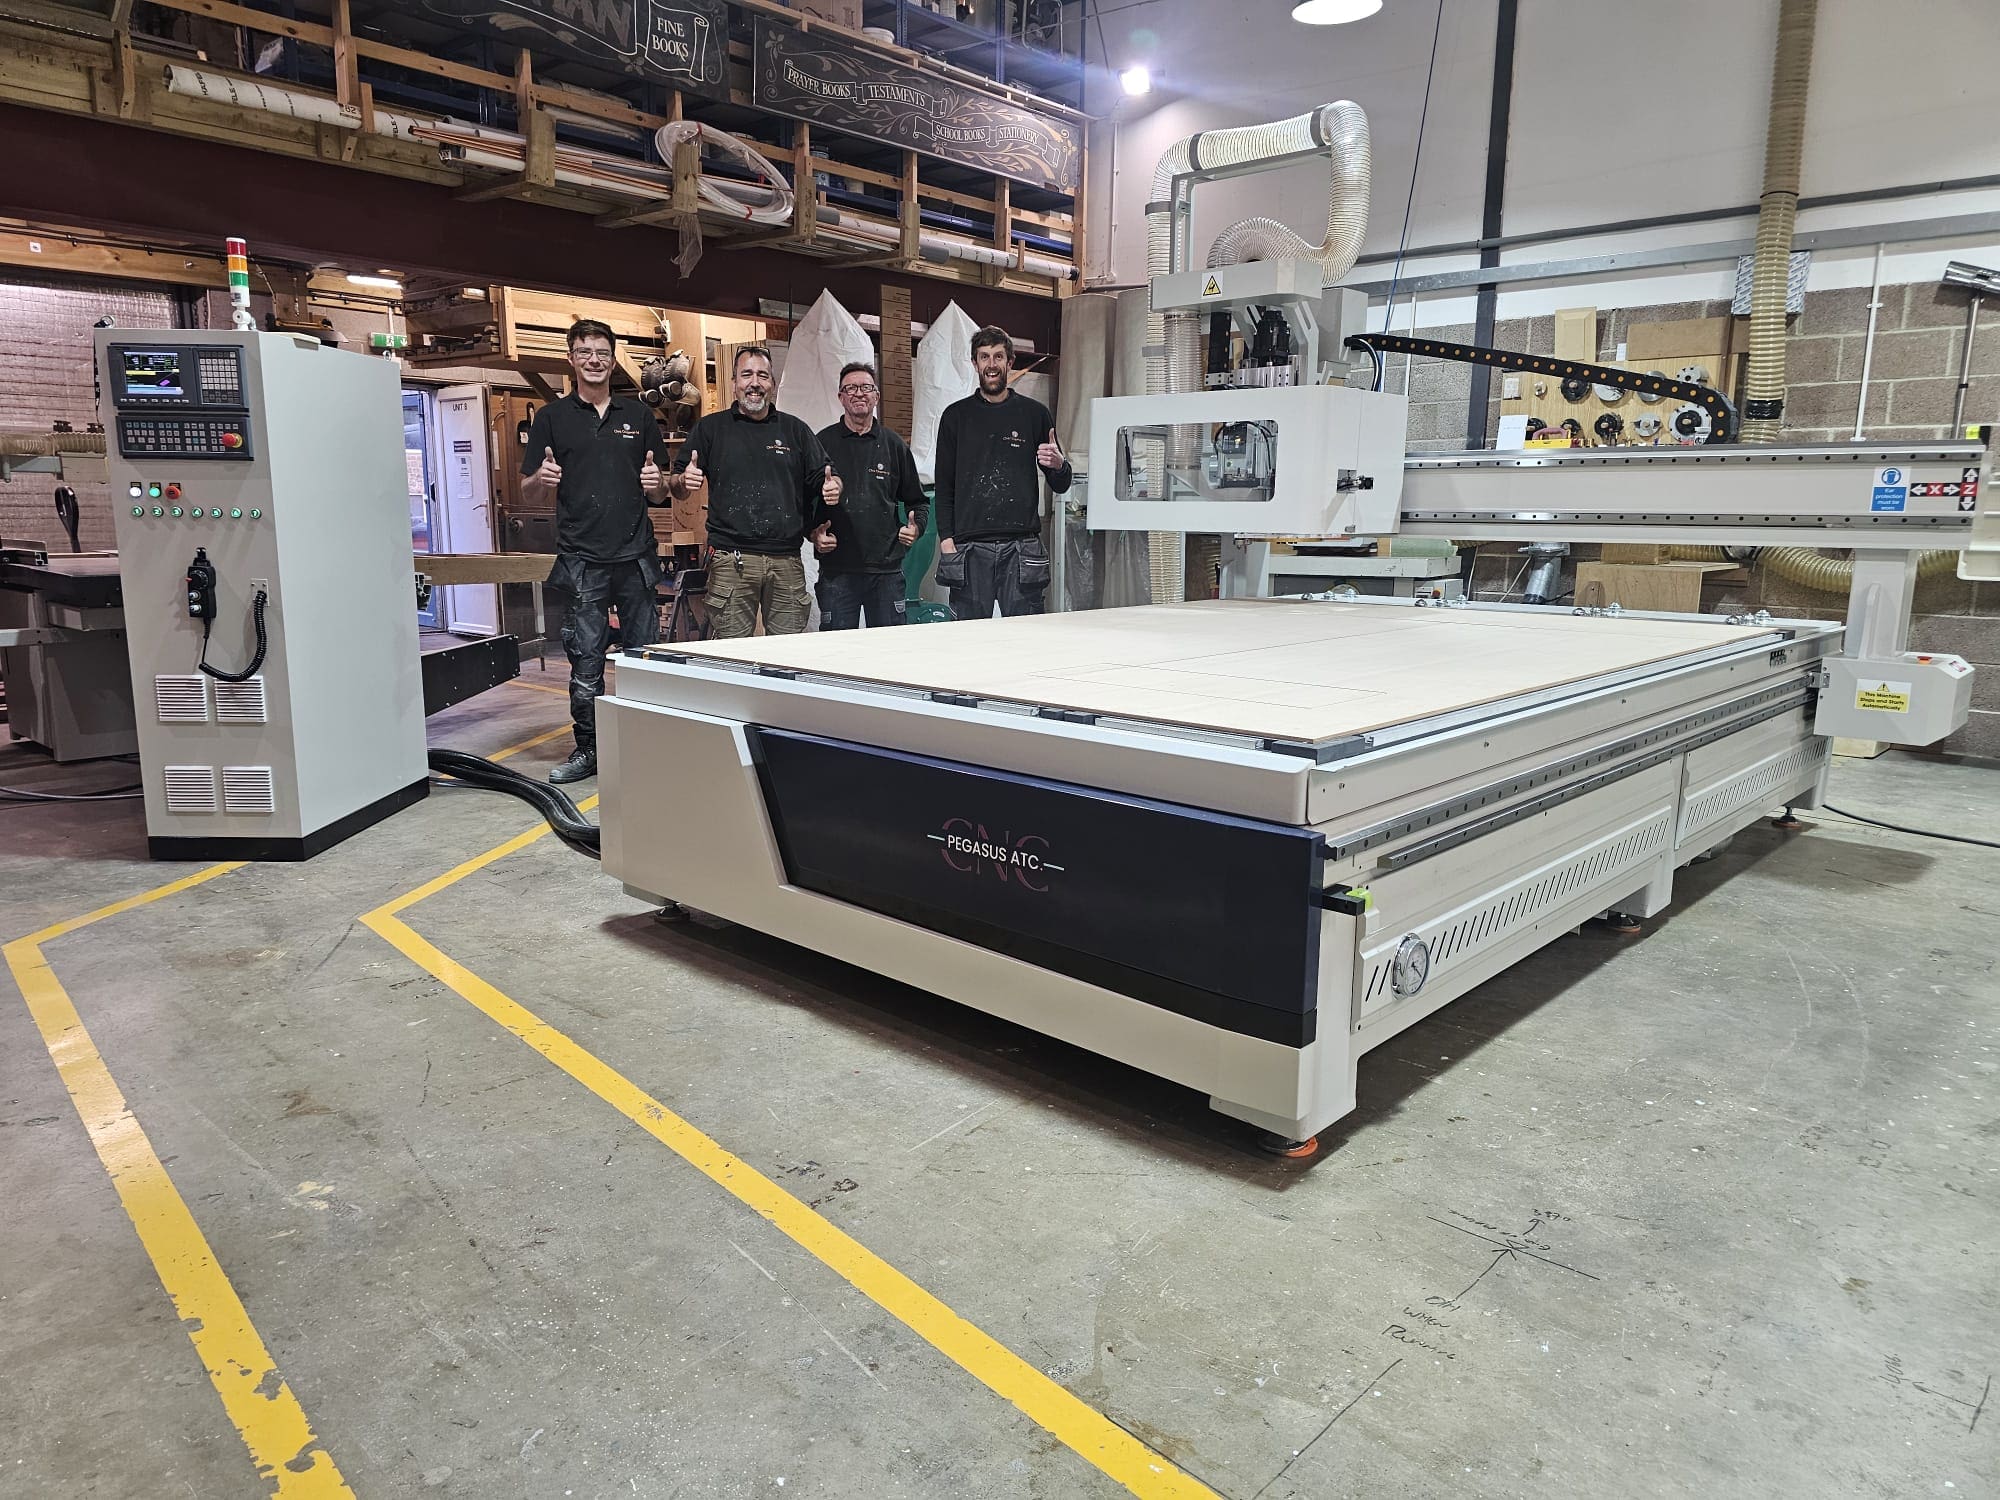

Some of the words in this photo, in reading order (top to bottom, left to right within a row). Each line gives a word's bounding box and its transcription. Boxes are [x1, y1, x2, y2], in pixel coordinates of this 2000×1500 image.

[657, 16, 686, 38] FINE
[652, 35, 689, 62] BOOKS
[787, 68, 821, 95] PRAYER
[822, 83, 851, 98] BOOKS
[867, 85, 926, 107] TESTAMENTS
[935, 124, 963, 141] SCHOOL
[964, 128, 986, 141] BOOKS
[999, 126, 1040, 145] STATIONERY
[1929, 485, 1942, 494] X
[1963, 485, 1975, 494] Z
[947, 834, 1007, 862] PEGASUS
